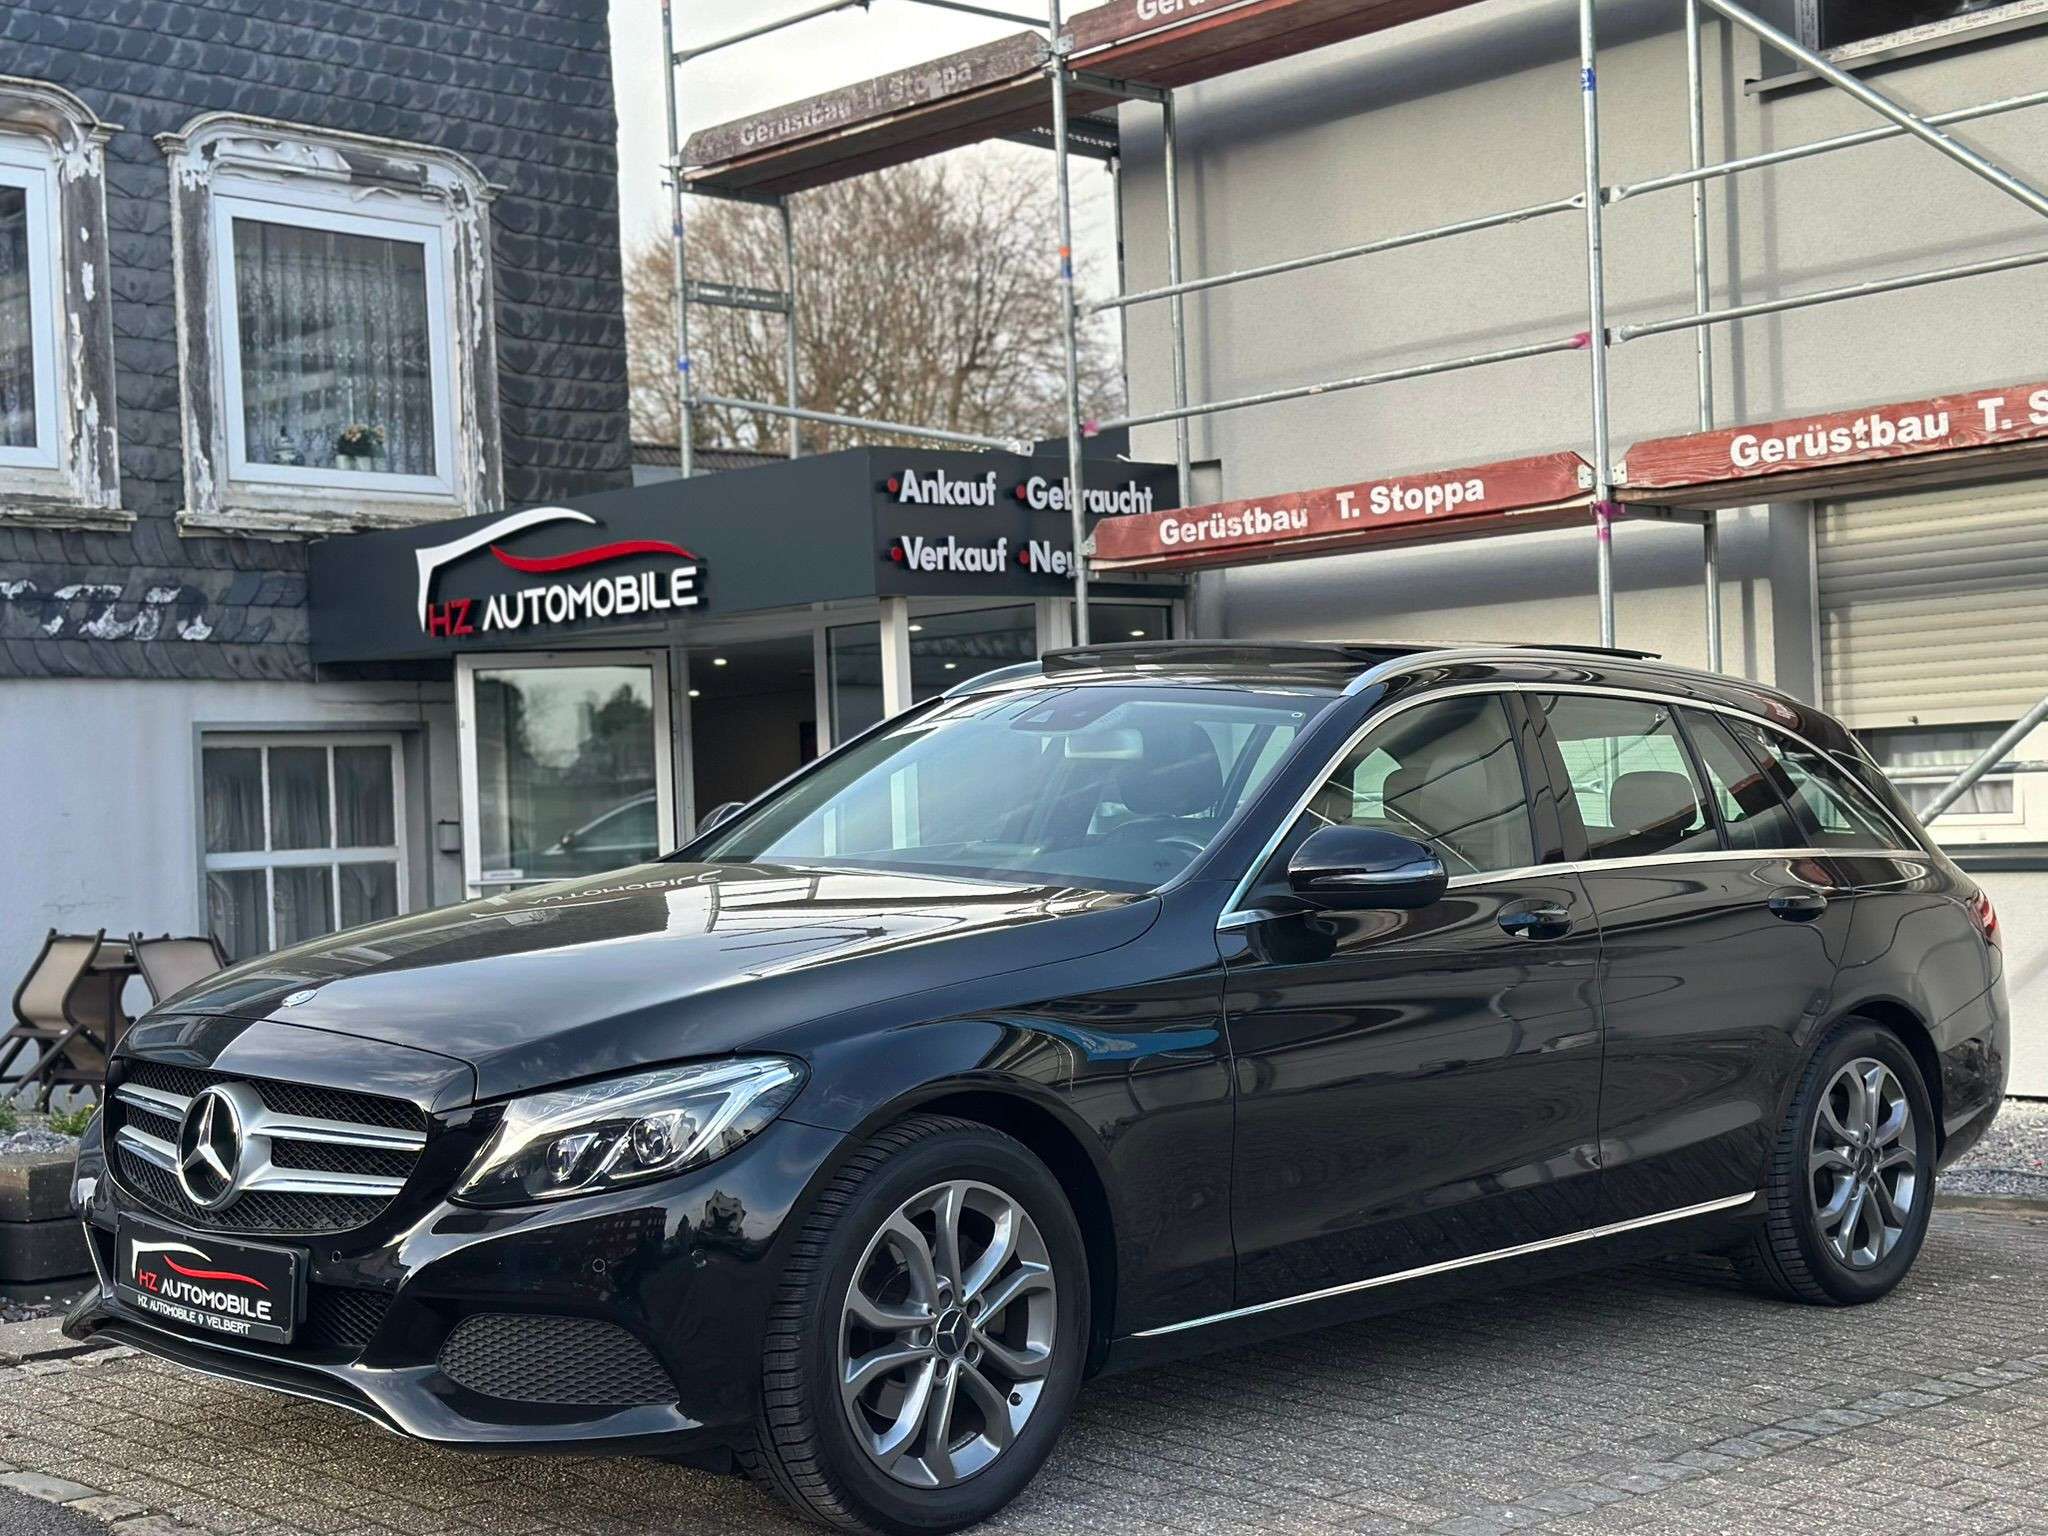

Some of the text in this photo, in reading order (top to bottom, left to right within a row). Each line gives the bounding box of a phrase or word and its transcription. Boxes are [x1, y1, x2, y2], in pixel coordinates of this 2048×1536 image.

[1136, 0, 1207, 20] Ger
[1730, 409, 1949, 467] Gerüstbau
[1977, 397, 2012, 432] T.
[899, 469, 996, 506] Ankauf
[1159, 478, 1485, 545] Gerüstbau T. Stoppa
[901, 535, 1007, 572] Verkauf
[428, 565, 698, 637] HZ AUTOMOBILE
[137, 1295, 251, 1335] HZ AUTOMOBILE VELBERT
[139, 1268, 272, 1321] HZ AUTOMOBILE
